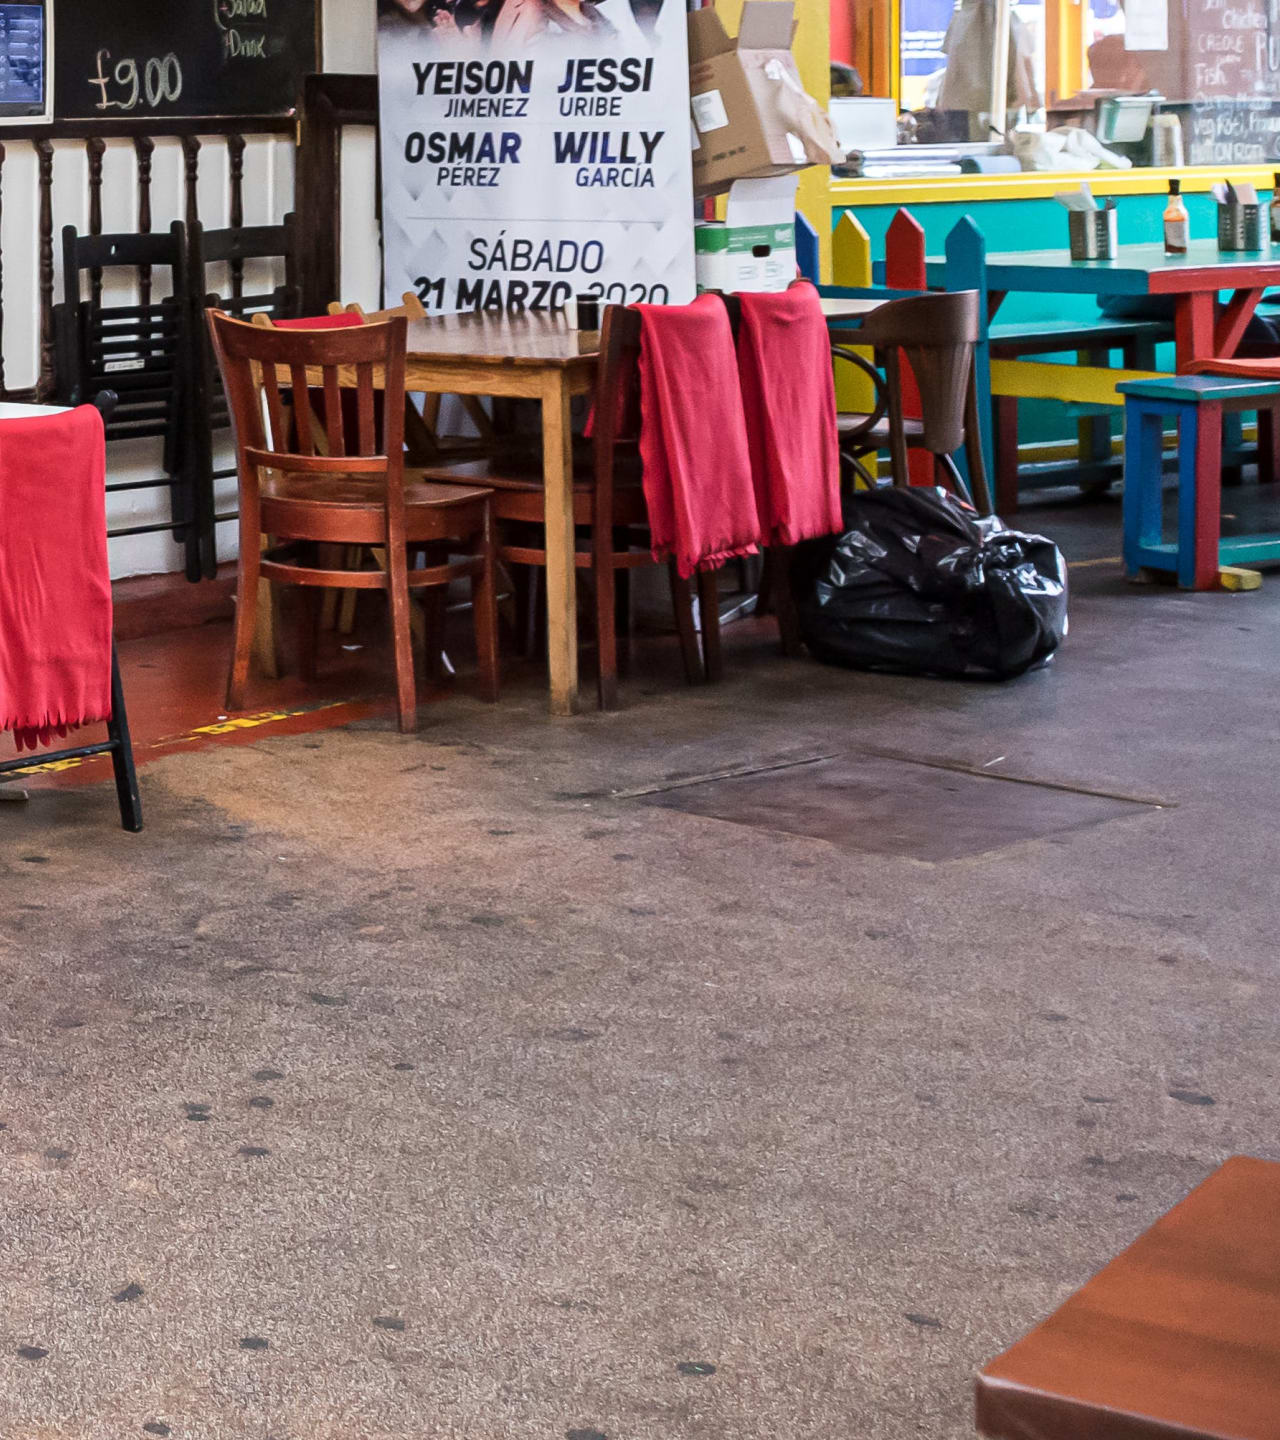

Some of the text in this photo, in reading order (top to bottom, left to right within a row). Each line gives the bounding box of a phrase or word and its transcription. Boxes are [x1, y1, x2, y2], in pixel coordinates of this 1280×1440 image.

[88, 48, 183, 110] £9.00
[412, 60, 534, 96] YEISON
[557, 57, 655, 94] JESSI
[443, 96, 529, 118] JIMENEZ
[559, 95, 622, 117] URIBE
[404, 130, 522, 165] OSMAR
[553, 129, 664, 165] WILLY
[437, 161, 500, 187] PÉREZ
[575, 161, 656, 188] GARCÍA
[468, 230, 604, 274] SÁBADO
[413, 276, 447, 309] 21
[455, 277, 572, 311] MARZO
